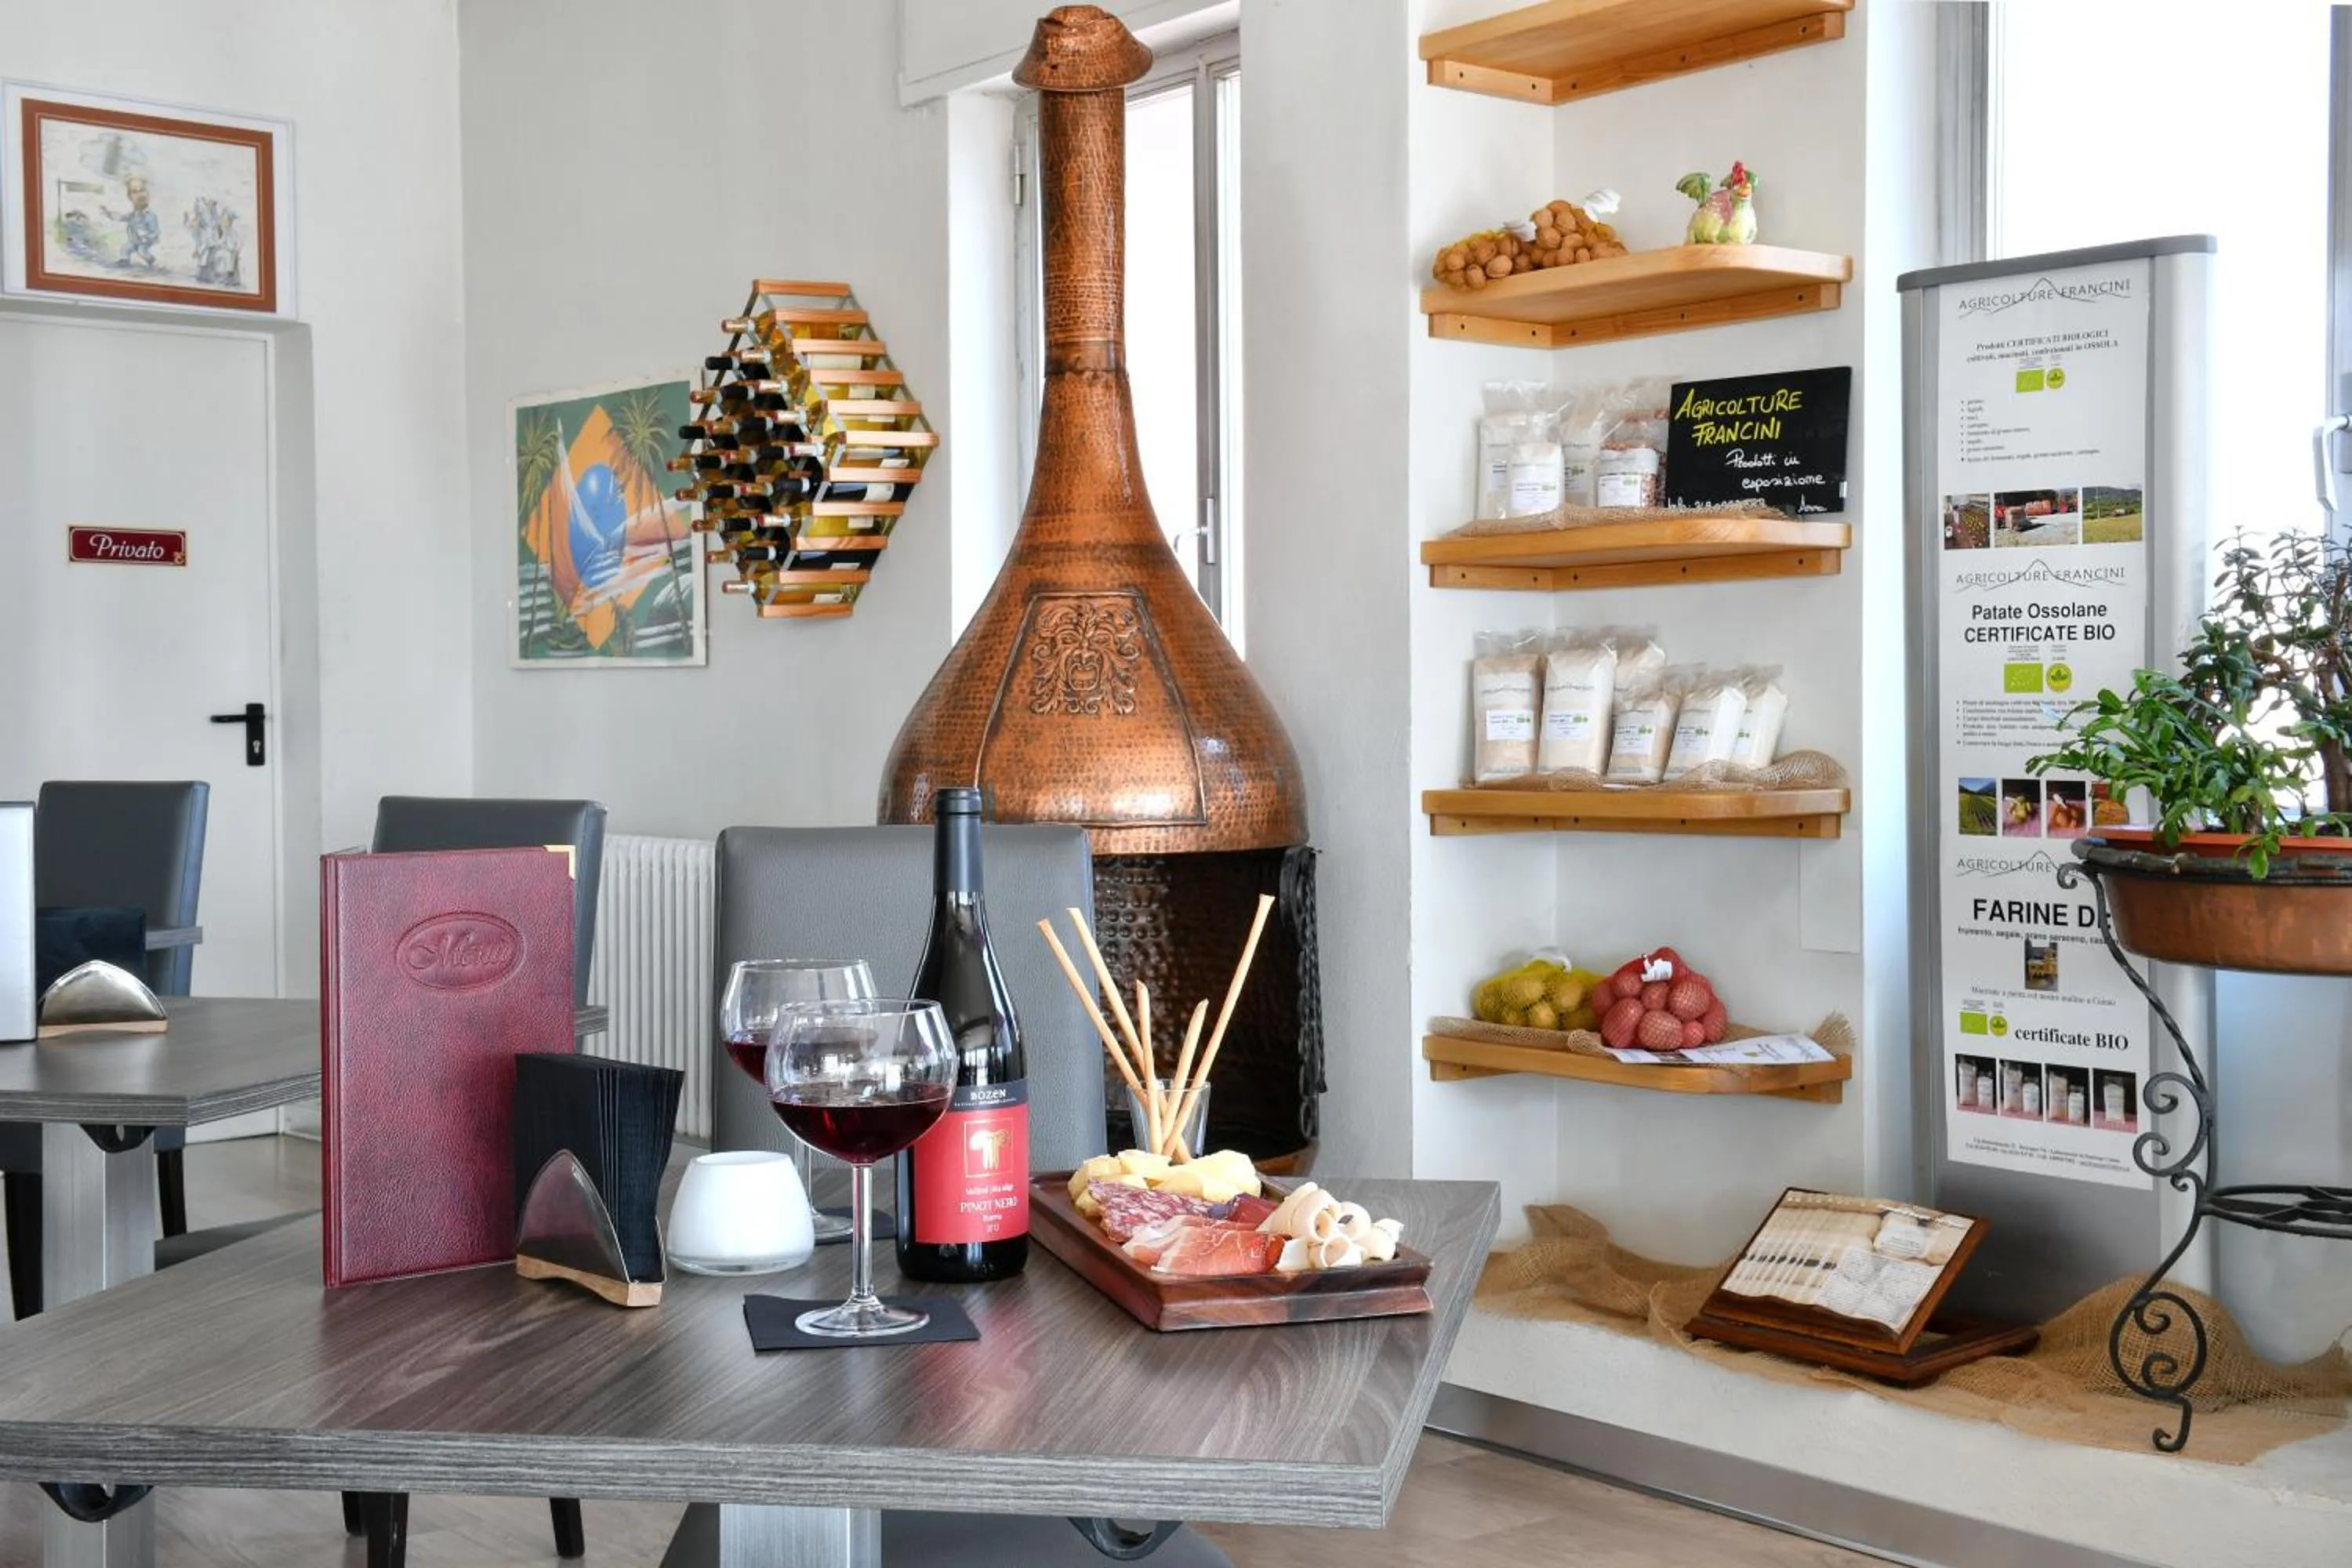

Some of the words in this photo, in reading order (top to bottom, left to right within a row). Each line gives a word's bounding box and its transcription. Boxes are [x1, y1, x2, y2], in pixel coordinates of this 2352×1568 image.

[1958, 288, 2056, 310] AGRICOLTURE
[2061, 278, 2131, 297] FRANCINI
[1675, 388, 1802, 420] AGRICOLTURE
[1692, 416, 1781, 447] FRANCINI
[1726, 448, 1777, 469] Prodotti
[1784, 452, 1801, 467] in
[1741, 472, 1826, 493] esposizione
[89, 534, 165, 560] Privato
[1956, 571, 2049, 585] AGRICOLTURE
[2055, 566, 2125, 581] FRANCINI
[1972, 604, 2023, 620] Patate
[2027, 601, 2107, 619] Ossolane
[1964, 626, 2078, 643] CERTIFICATE
[2084, 623, 2116, 641] BIO
[1956, 858, 2052, 873] AGRICOLTURE
[1973, 898, 2068, 926] FARINE
[408, 928, 515, 971] Menu
[2015, 1028, 2091, 1047] certificate
[2095, 1033, 2129, 1051] BIO
[960, 1200, 992, 1213] PINOT
